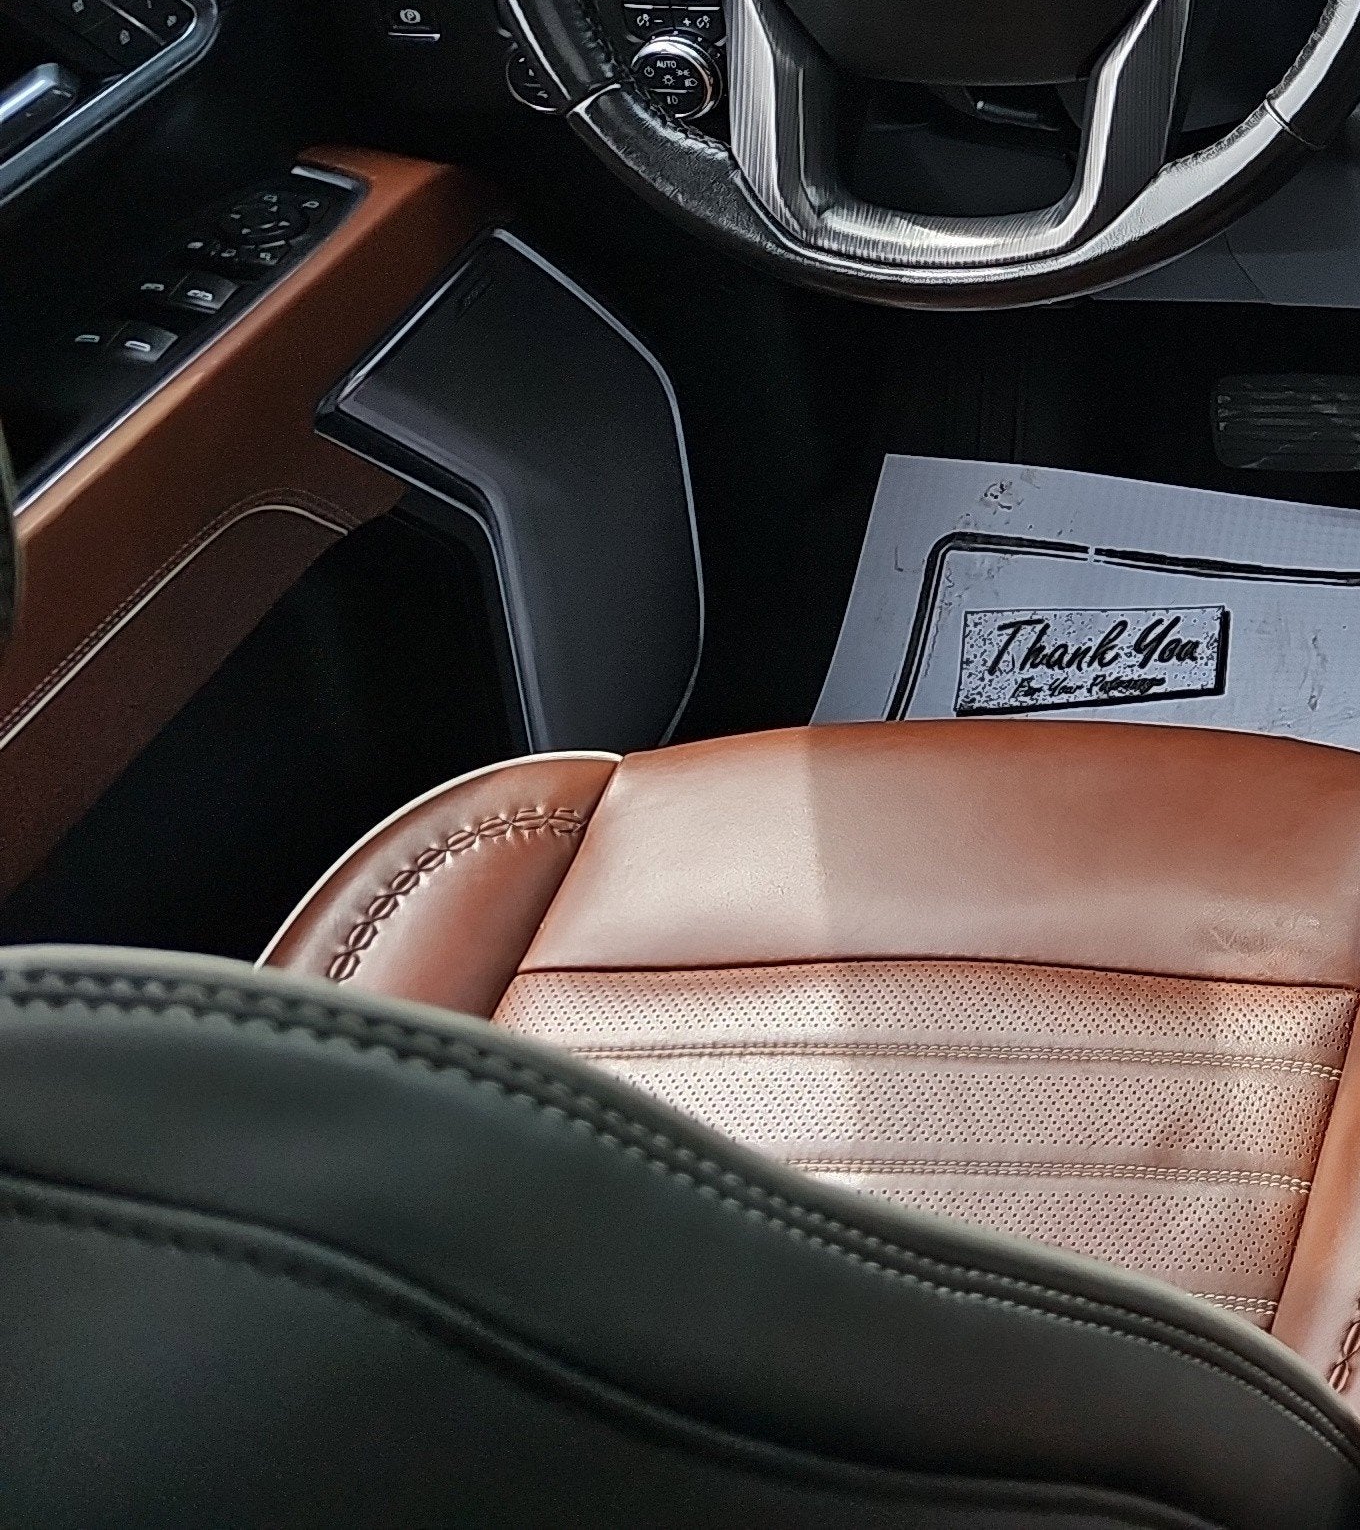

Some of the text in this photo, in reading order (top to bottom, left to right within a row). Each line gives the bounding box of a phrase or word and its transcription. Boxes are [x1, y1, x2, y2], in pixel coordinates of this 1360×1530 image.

[656, 59, 677, 68] AUTO
[988, 615, 1200, 676] Thank You
